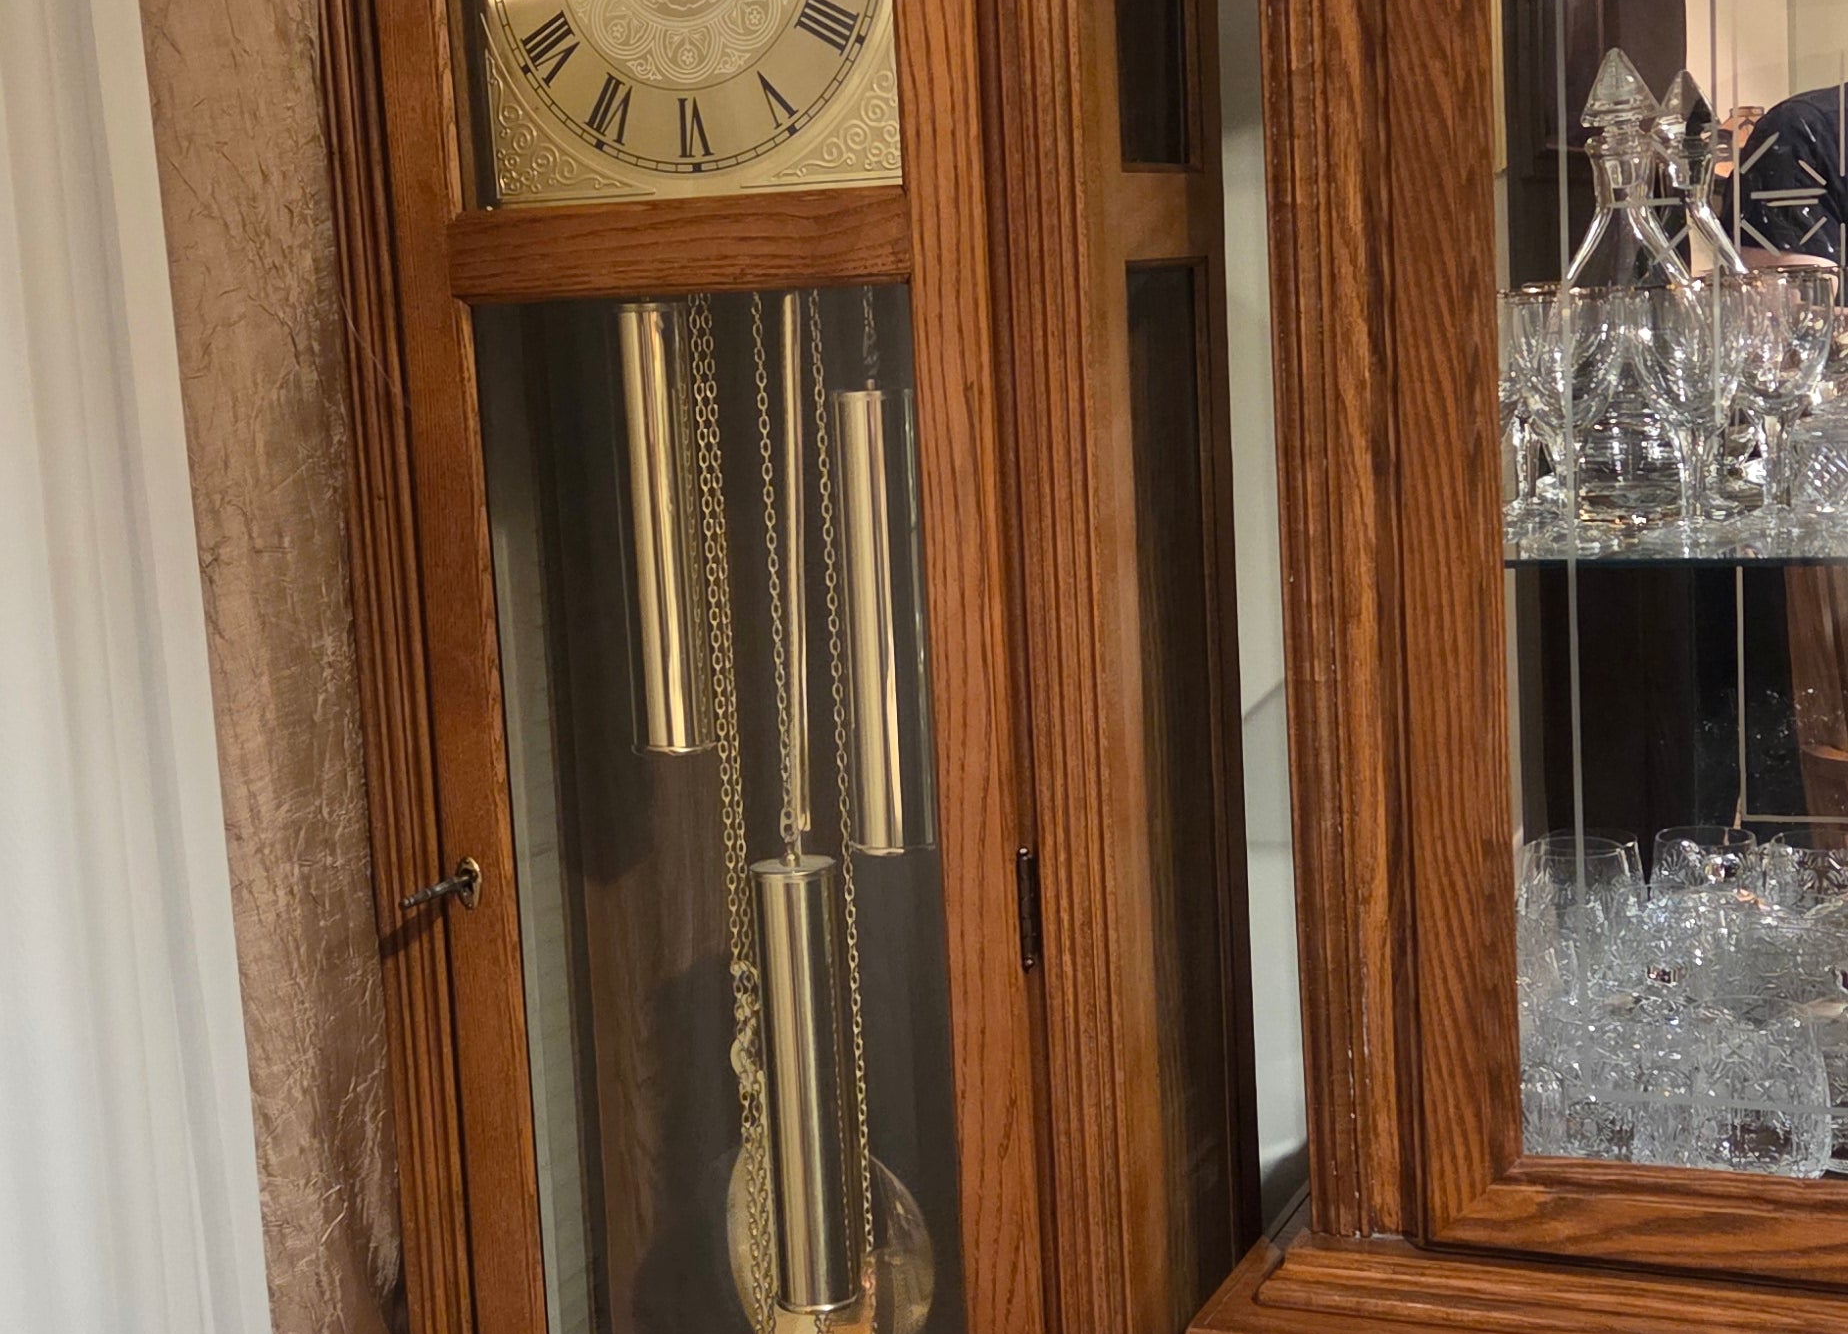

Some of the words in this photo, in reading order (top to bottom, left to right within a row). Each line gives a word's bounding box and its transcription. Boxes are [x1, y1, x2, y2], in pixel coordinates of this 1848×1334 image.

[520, 10, 580, 88] VIII
[584, 72, 633, 146] VII
[678, 97, 715, 158] VI
[757, 70, 798, 130] V
